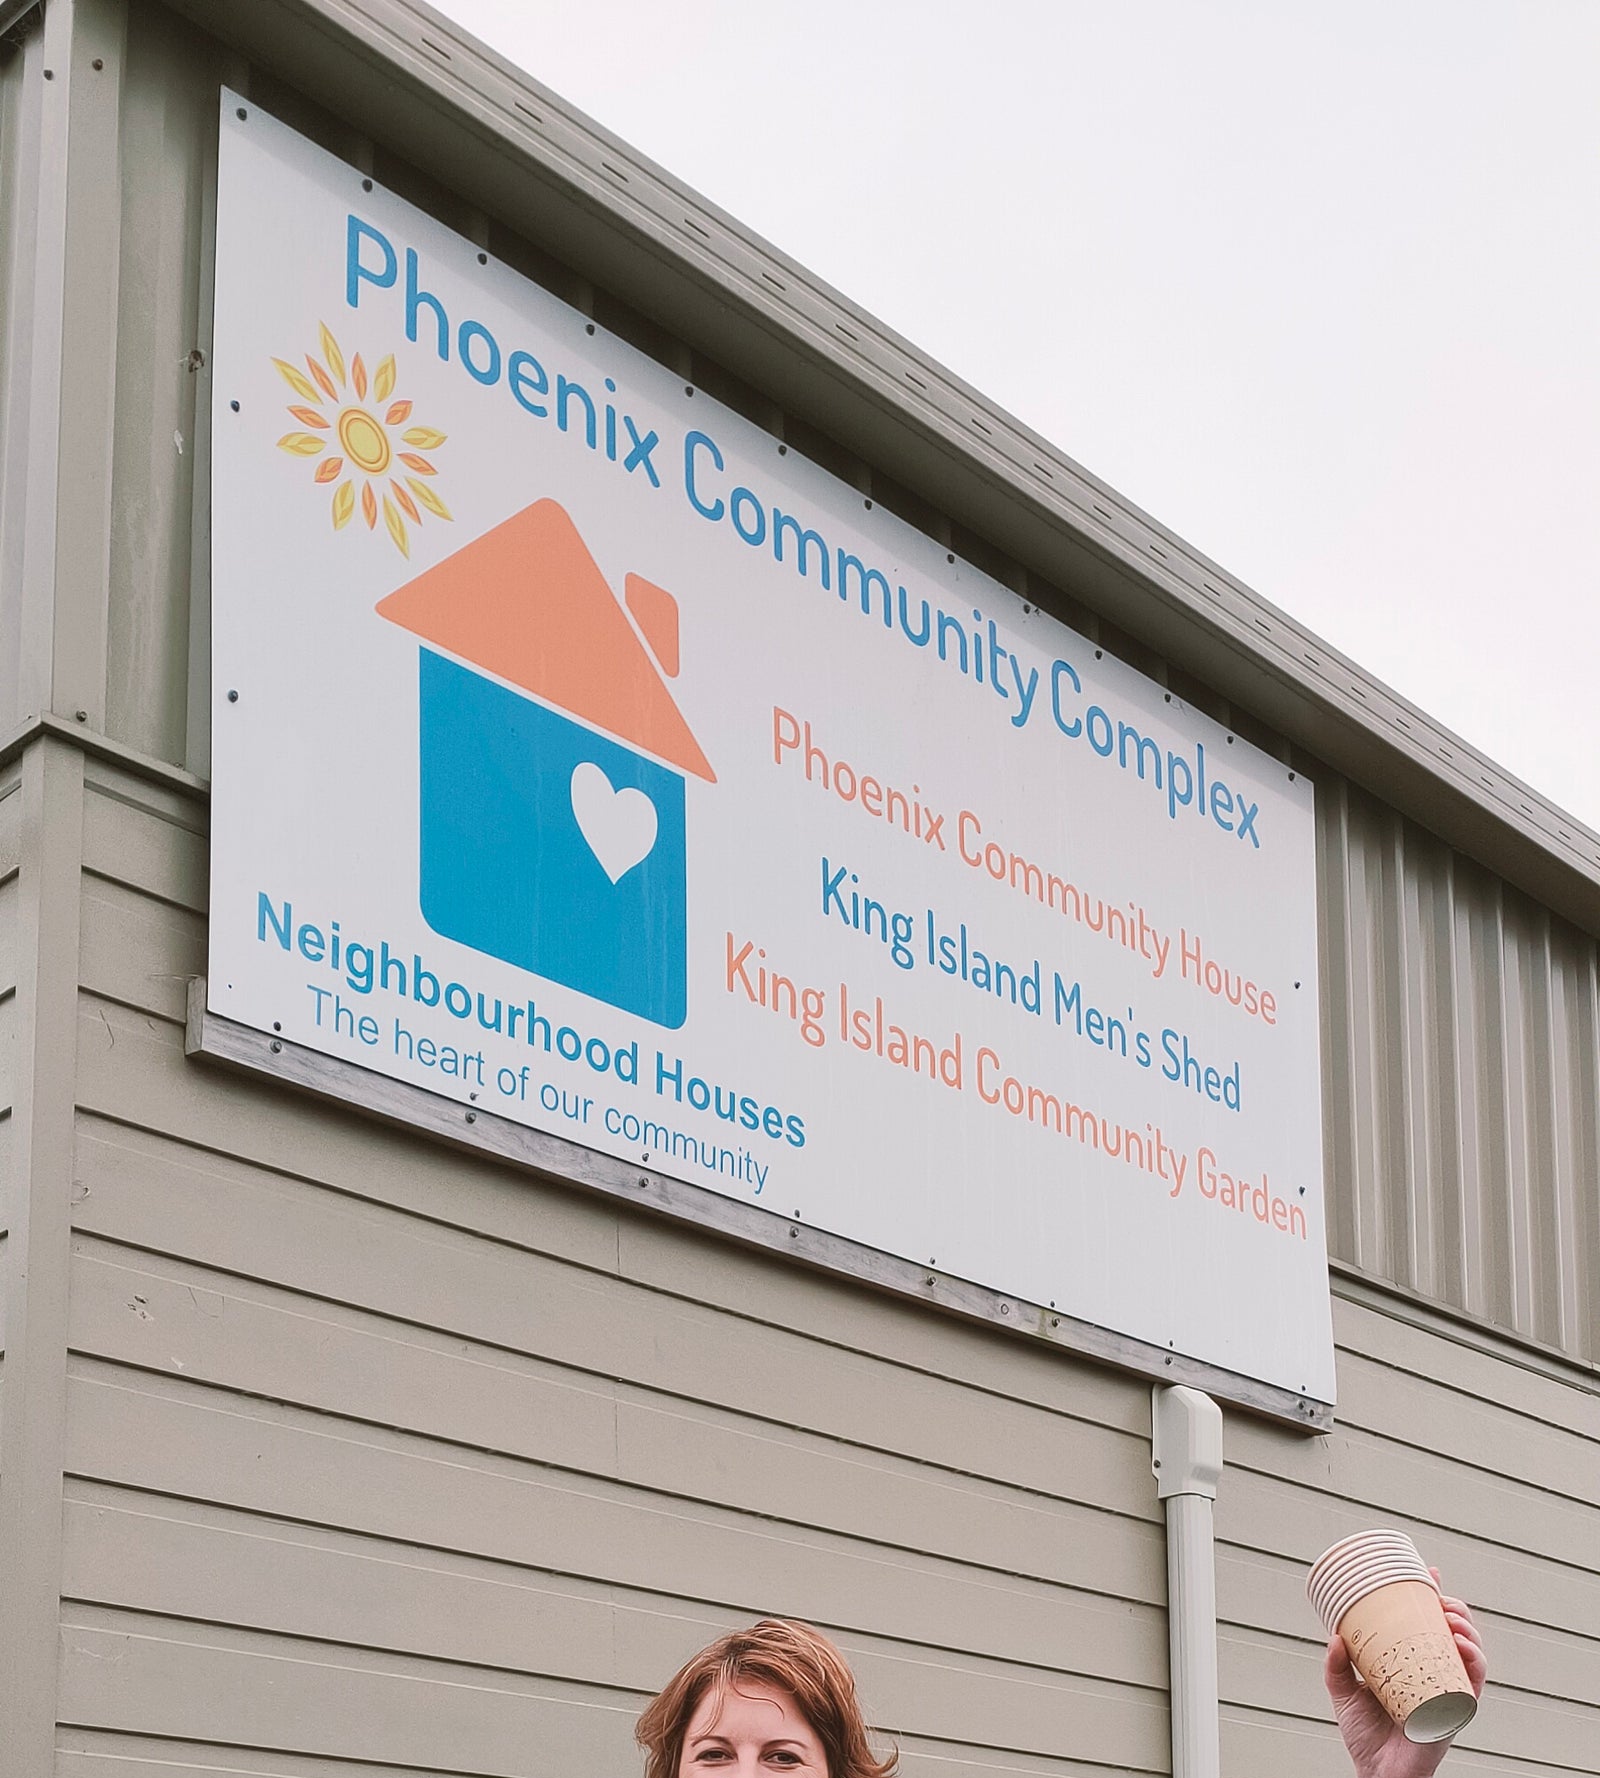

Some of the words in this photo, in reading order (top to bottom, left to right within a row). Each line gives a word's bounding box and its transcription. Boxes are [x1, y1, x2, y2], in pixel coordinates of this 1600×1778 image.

[346, 214, 660, 488] Phoenix
[685, 431, 1038, 727] Community
[1052, 660, 1258, 847] Complex
[773, 707, 944, 850] Phoenix
[958, 811, 1170, 978] Community
[1181, 930, 1276, 1024] House
[822, 858, 914, 969] King
[928, 910, 1040, 1014] Island
[1054, 973, 1151, 1067] Men's
[1162, 1029, 1240, 1110] Shed
[258, 892, 638, 1085] Neighbourhood
[656, 1052, 805, 1147] Houses
[308, 985, 378, 1045] The
[394, 1019, 484, 1086] heart
[498, 1066, 529, 1100] of
[540, 1084, 593, 1123] our
[605, 1108, 767, 1194] community
[726, 933, 826, 1047] King
[840, 984, 962, 1089] Island
[977, 1048, 1186, 1197] Community
[1198, 1148, 1306, 1237] Garden
